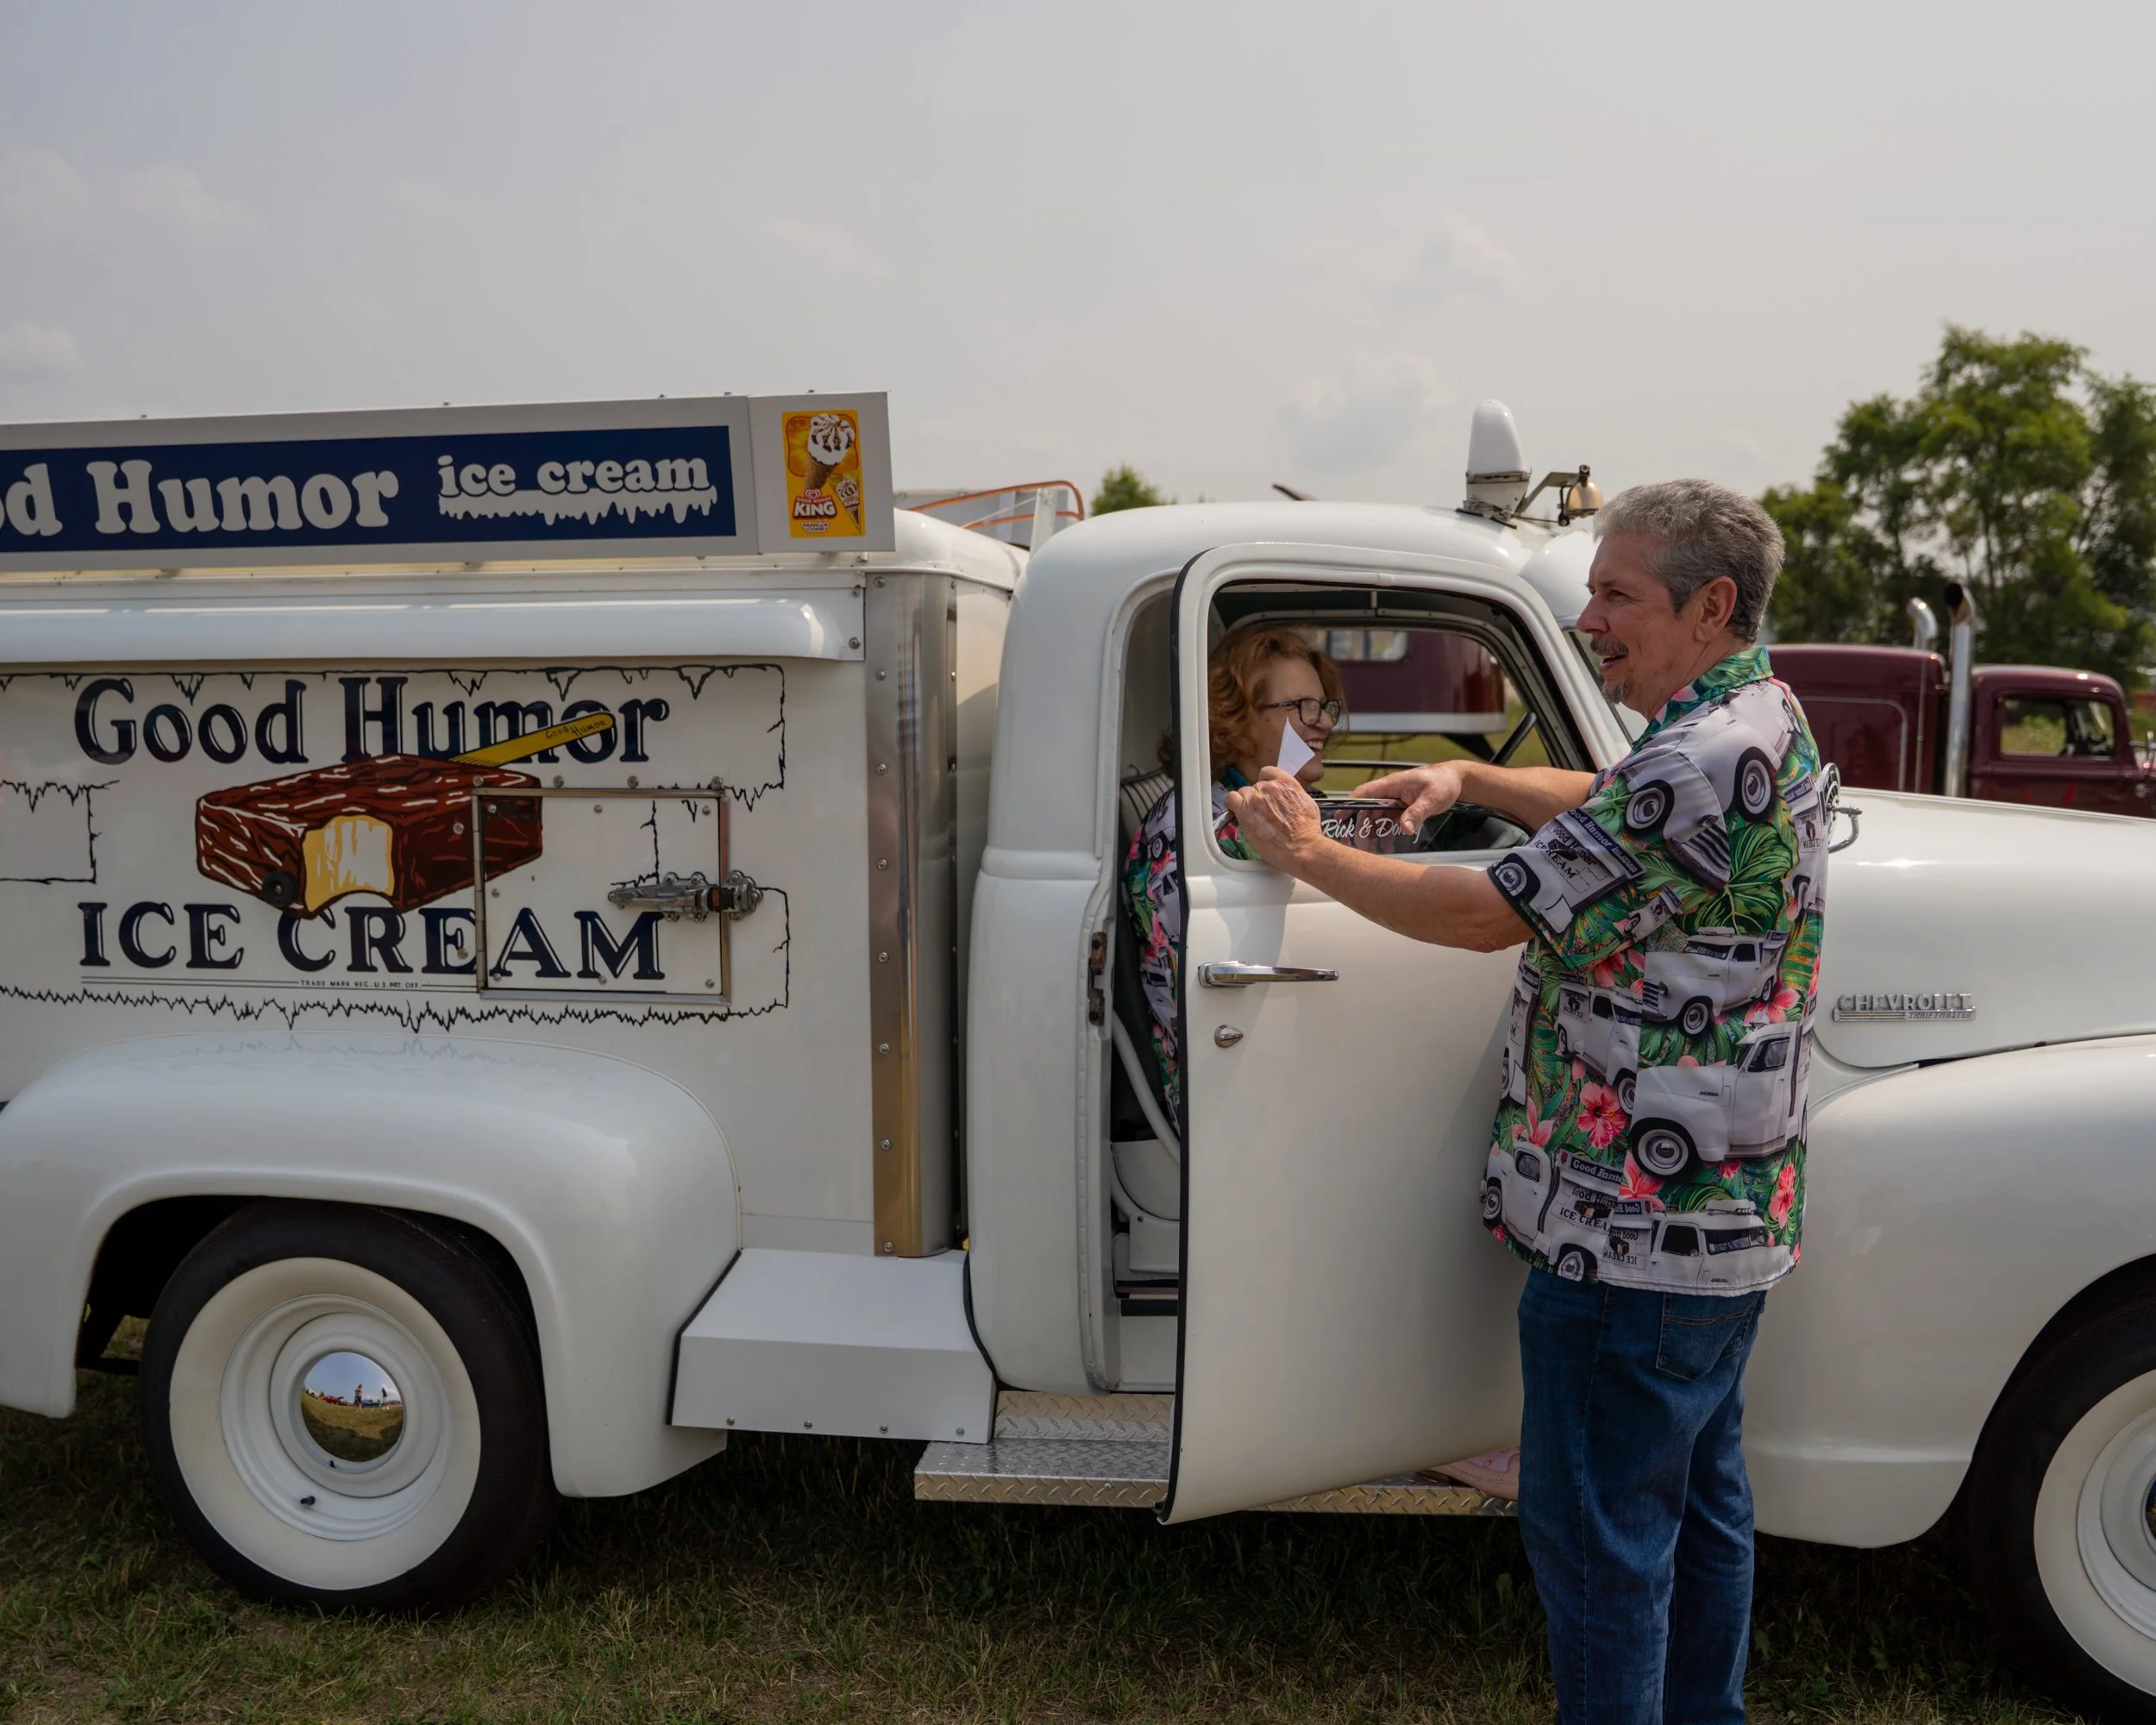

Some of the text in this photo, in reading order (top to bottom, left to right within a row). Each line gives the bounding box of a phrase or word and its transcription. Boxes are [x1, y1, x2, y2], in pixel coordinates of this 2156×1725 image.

[87, 459, 398, 535] Humor
[438, 455, 517, 498] ice
[536, 456, 711, 496] cream
[793, 501, 836, 517] KING
[74, 676, 670, 766] Good Humor
[545, 725, 570, 739] Good
[1320, 818, 1356, 838] Rick
[1358, 817, 1374, 838] &
[1583, 818, 1614, 847] Humor
[78, 901, 666, 981] ICE CREAM
[1837, 994, 1974, 1012] CHEVROLET
[1908, 1011, 1973, 1019] THRIFTMASTER
[1572, 1158, 1596, 1175] Good
[1559, 1207, 1577, 1220] ICE
